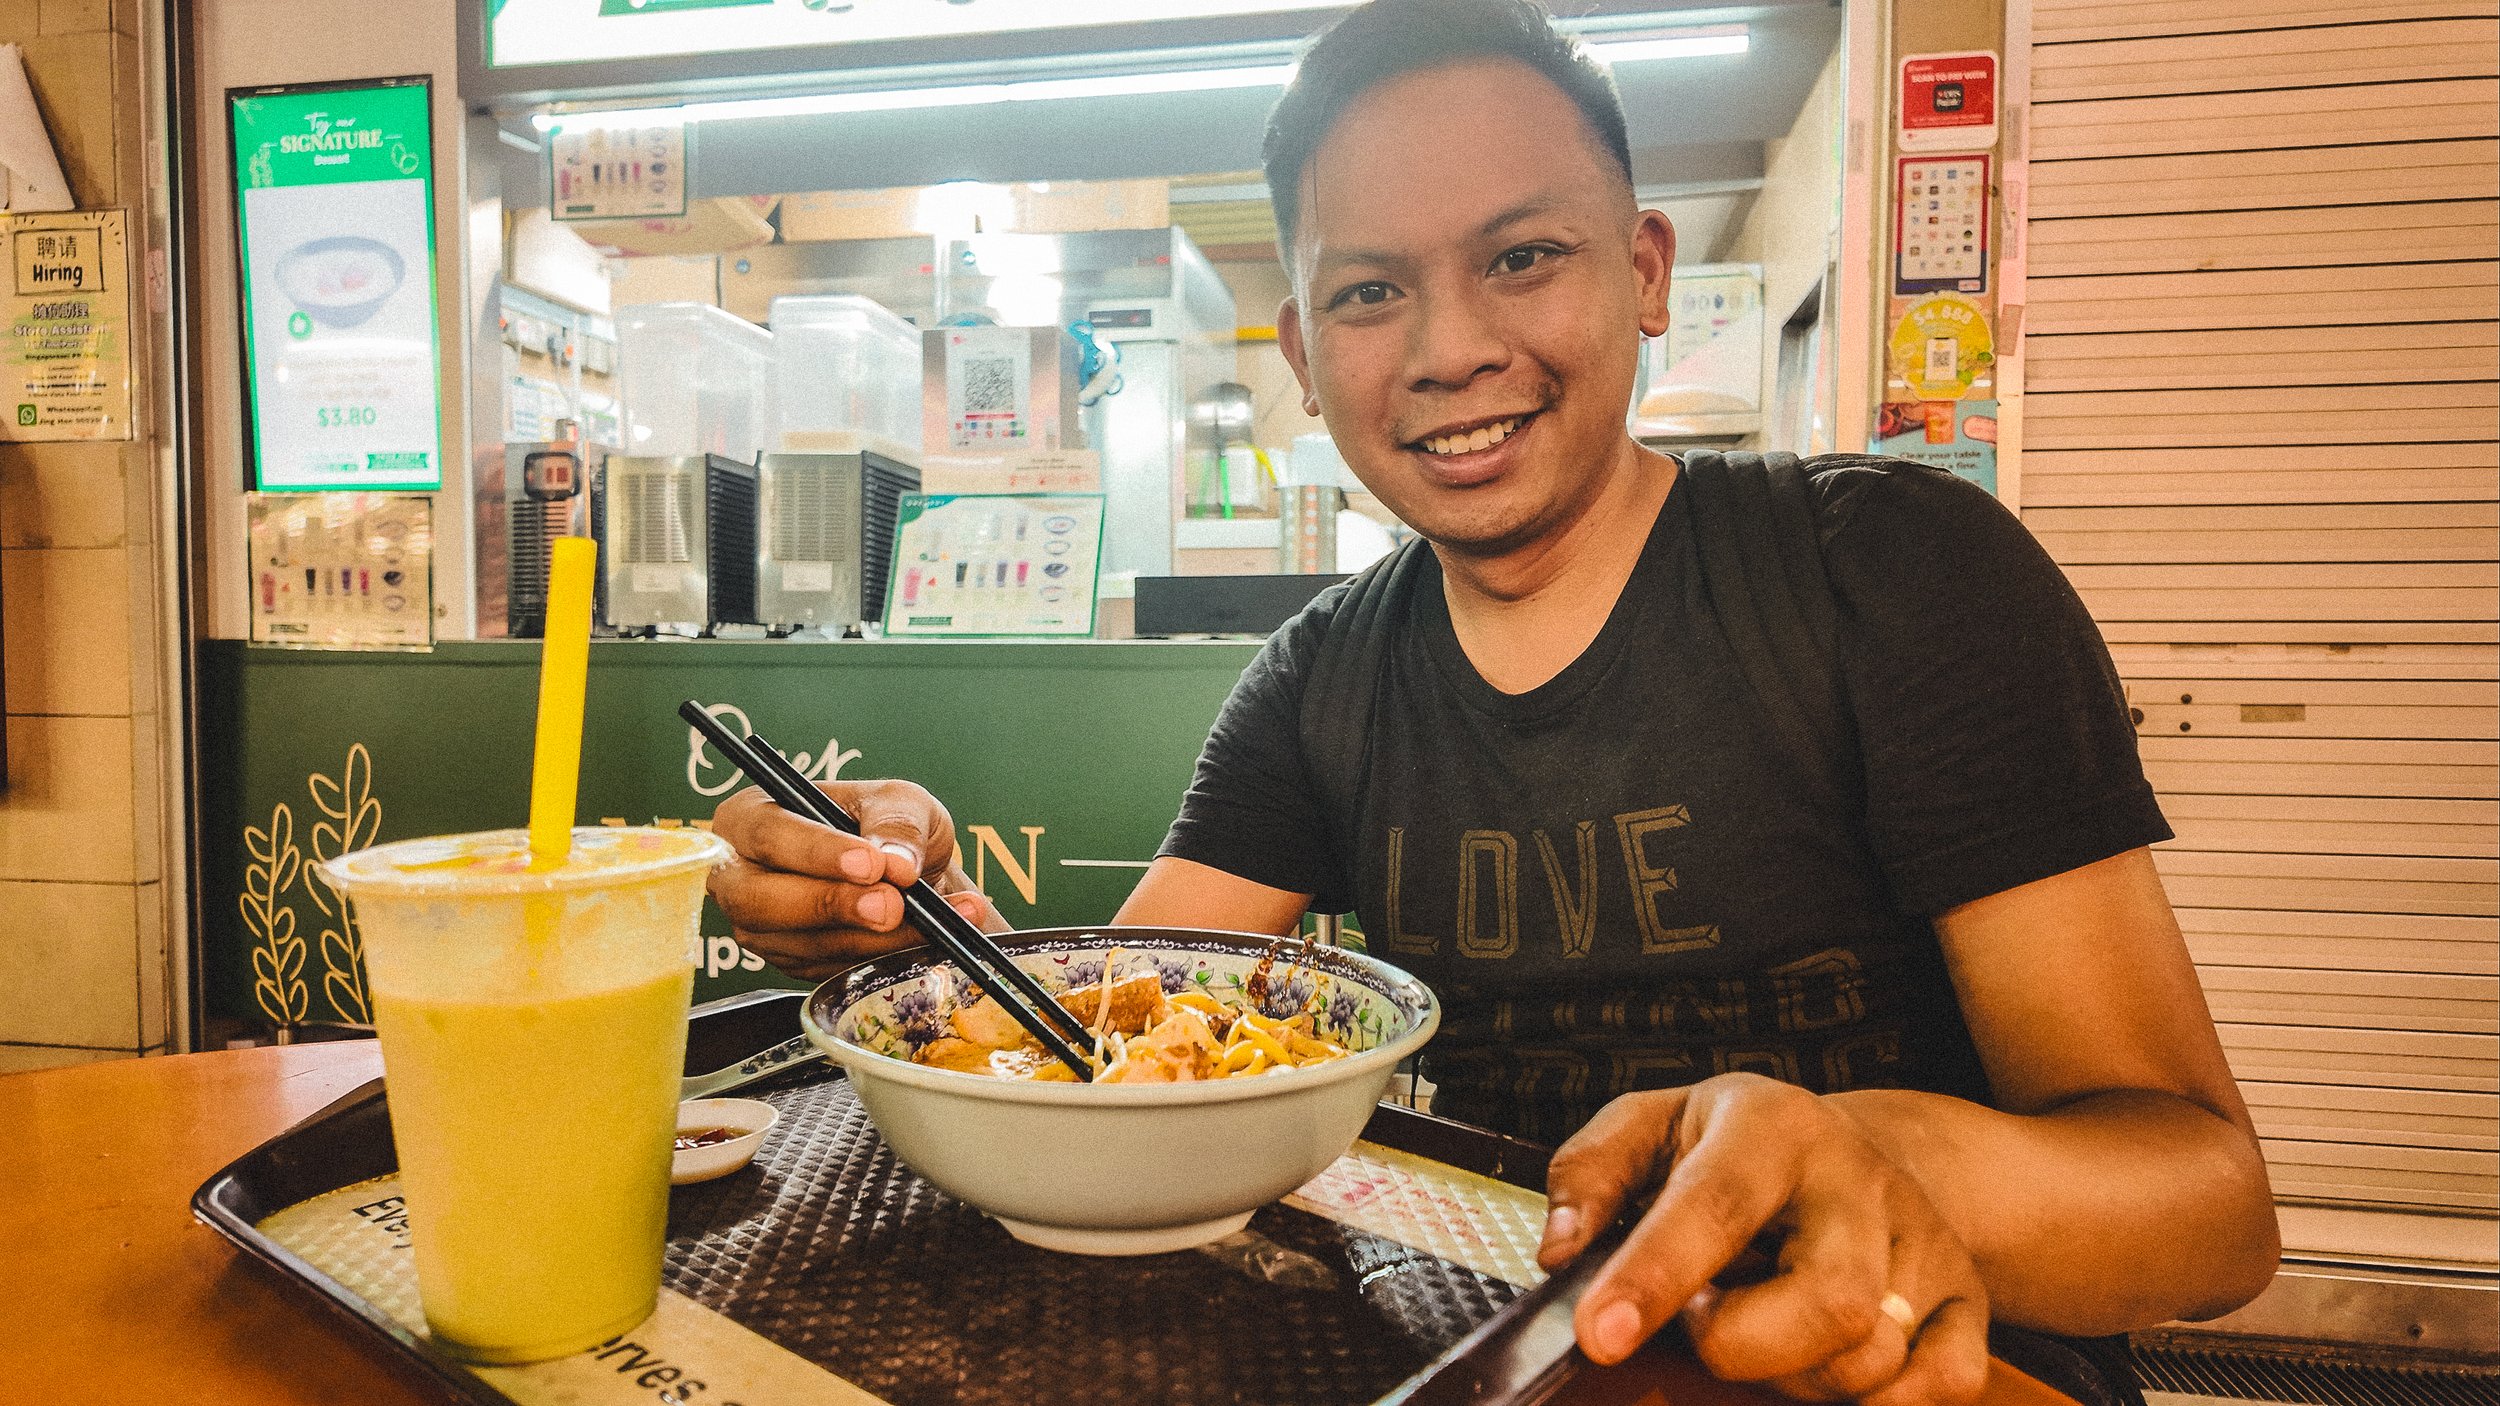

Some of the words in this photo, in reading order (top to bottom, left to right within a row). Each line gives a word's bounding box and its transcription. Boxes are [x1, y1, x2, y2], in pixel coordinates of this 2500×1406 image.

[280, 128, 384, 155] SIGNATURE
[33, 263, 83, 288] Hiring
[317, 404, 377, 428] $3.80
[1386, 803, 1721, 960] LOVE
